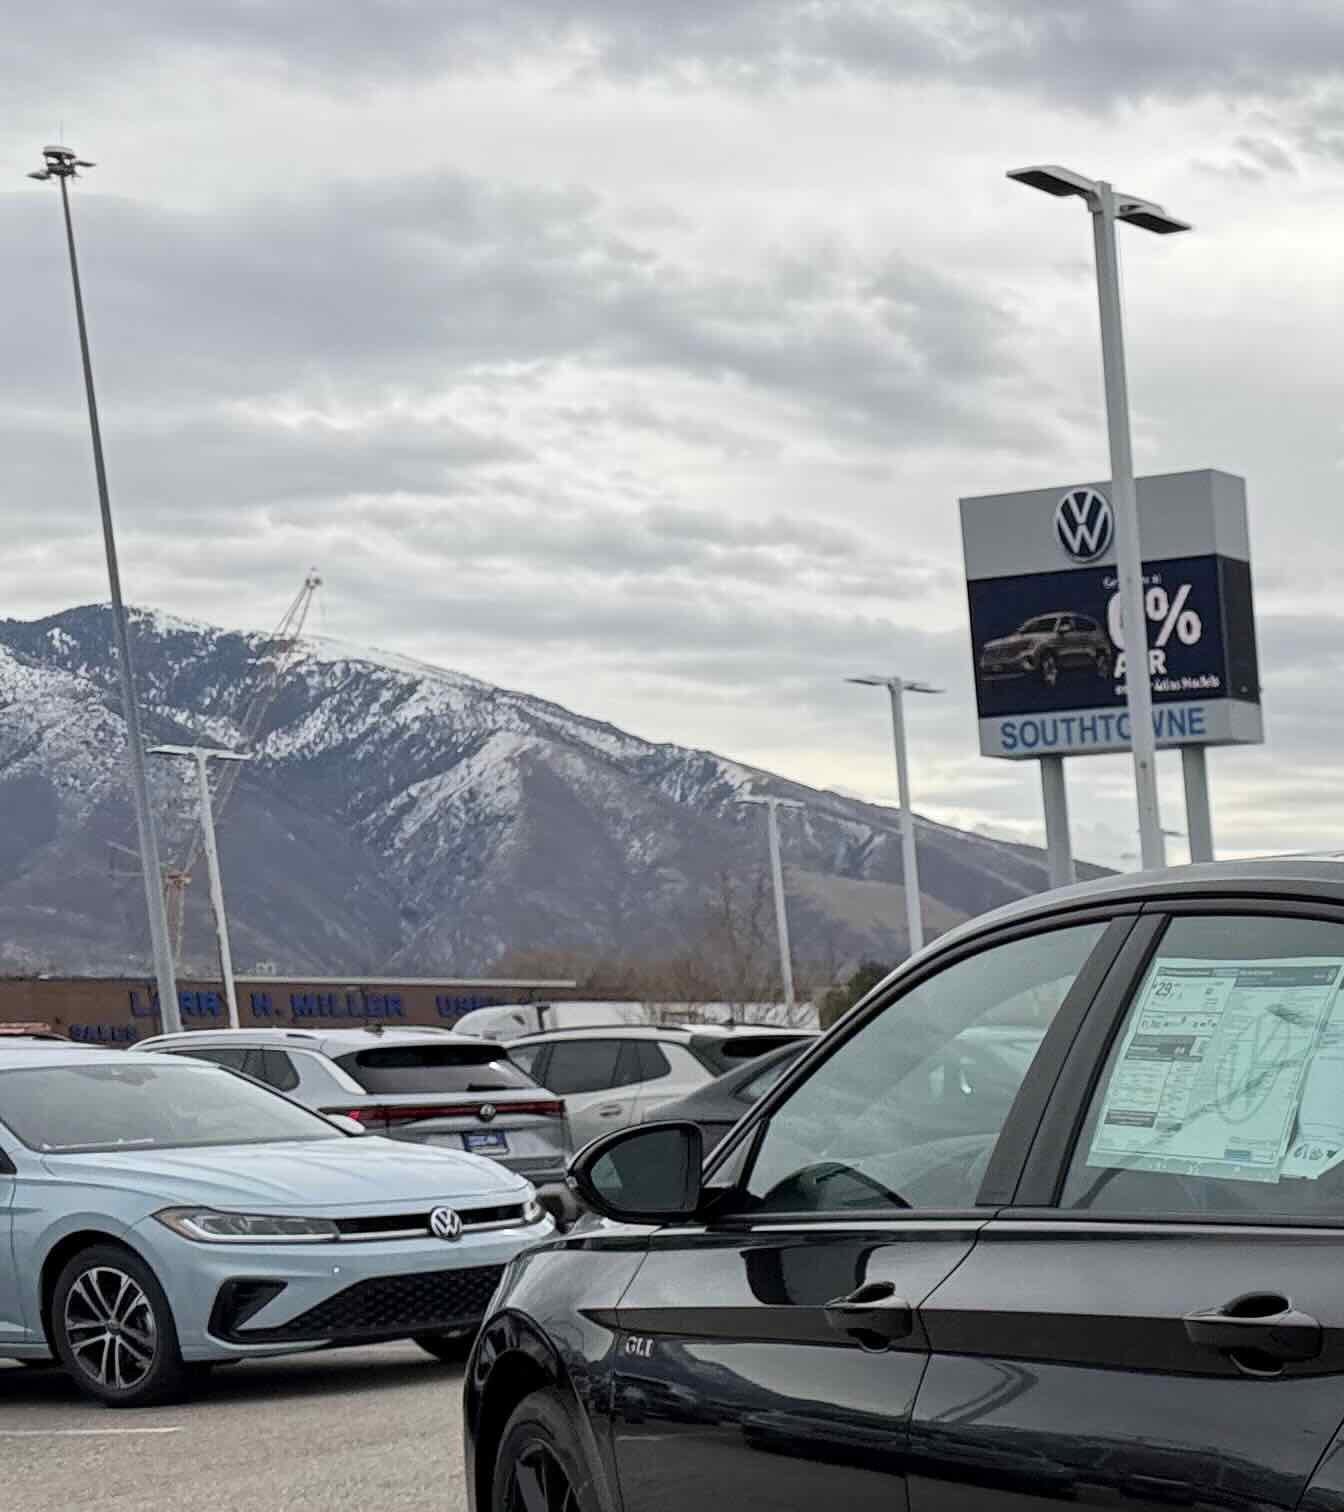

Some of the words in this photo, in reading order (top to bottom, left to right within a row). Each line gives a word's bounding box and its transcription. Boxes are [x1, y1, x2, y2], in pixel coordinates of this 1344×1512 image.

[1113, 648, 1168, 678] AR
[130, 991, 234, 1017] LRR
[626, 1336, 653, 1358] GLI
